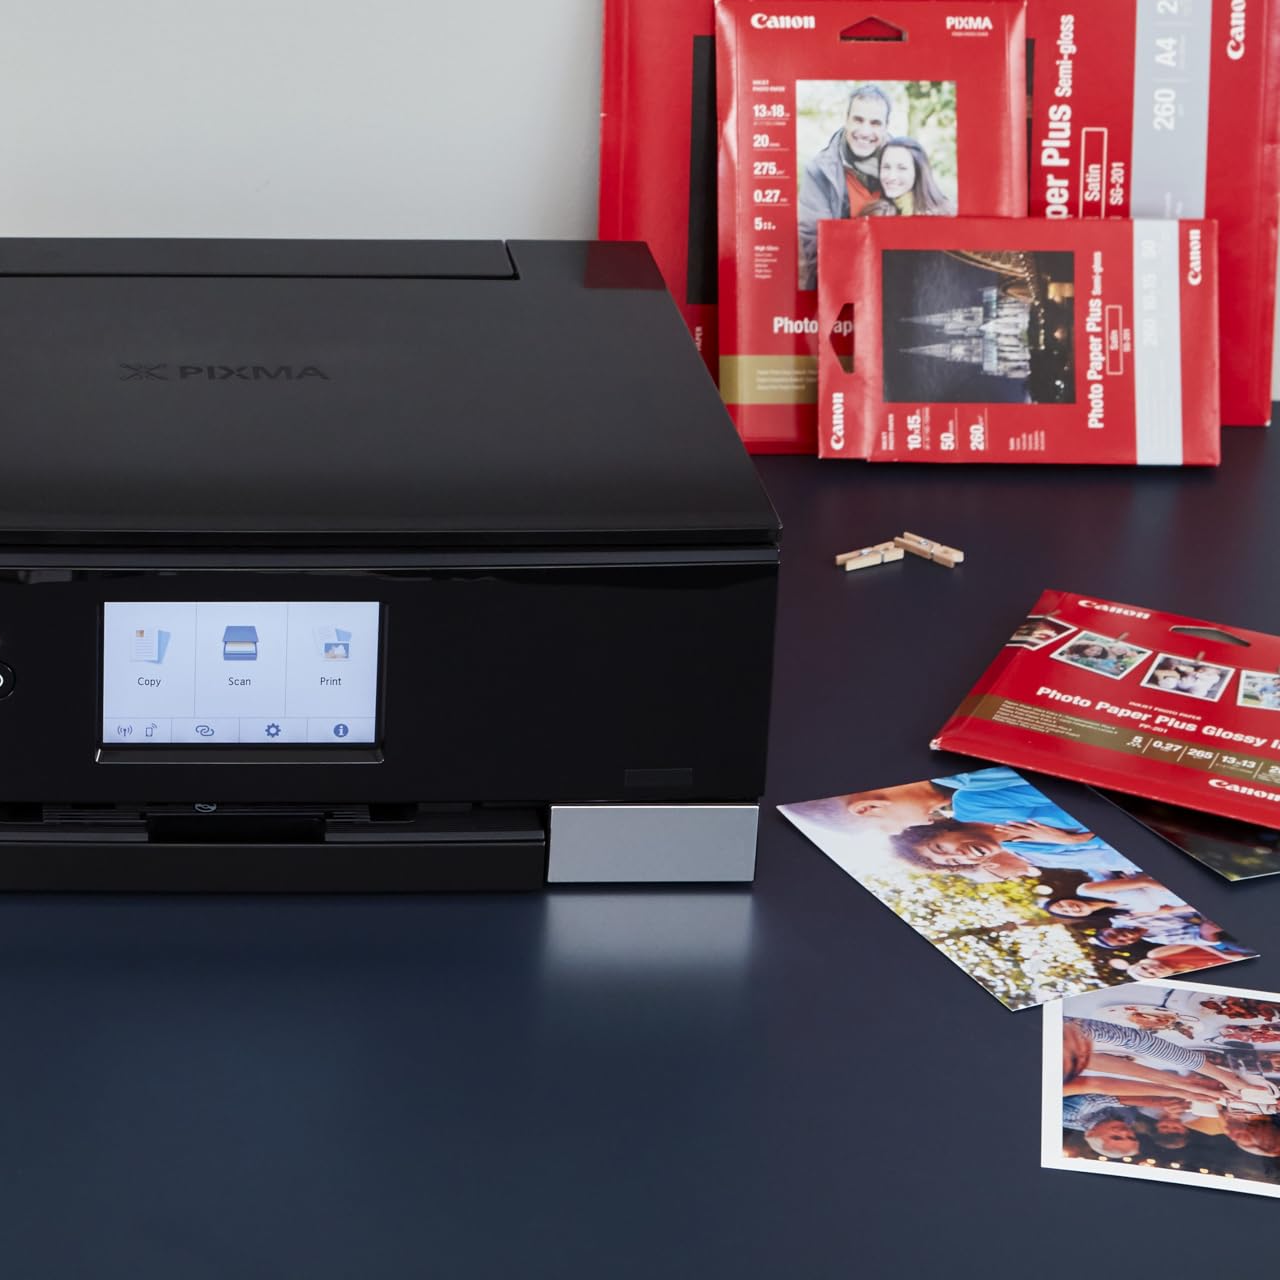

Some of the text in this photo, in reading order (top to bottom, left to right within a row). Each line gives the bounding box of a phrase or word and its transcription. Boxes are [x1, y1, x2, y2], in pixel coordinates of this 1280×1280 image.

[750, 12, 993, 31] Canon PIXMA
[1054, 14, 1078, 98] Semi-gloss
[1154, 37, 1178, 67] A4
[1152, 87, 1177, 132] 260
[752, 133, 770, 148] 20
[1040, 104, 1073, 168] Plus
[753, 161, 778, 175] 275
[1084, 163, 1102, 202] Satin
[753, 189, 781, 203] 0.27
[754, 217, 763, 231] 5
[1187, 228, 1202, 286] Canon
[773, 315, 819, 334] Photo
[1086, 298, 1103, 333] Plus
[1086, 335, 1106, 381] Paper
[178, 364, 331, 381] PIXMA
[1087, 383, 1105, 429] Photo
[830, 391, 845, 451] Canon
[940, 432, 955, 451] 50
[1077, 598, 1152, 621] Canon
[137, 676, 342, 688] Copy Scan Print
[1036, 686, 1092, 708] Photo
[1095, 701, 1153, 722] Paper
[1154, 714, 1198, 733] Plus
[1201, 724, 1268, 748] Glossy
[1152, 740, 1183, 752] 0.27
[1186, 748, 1215, 760] 265
[1208, 778, 1280, 802] Canon
